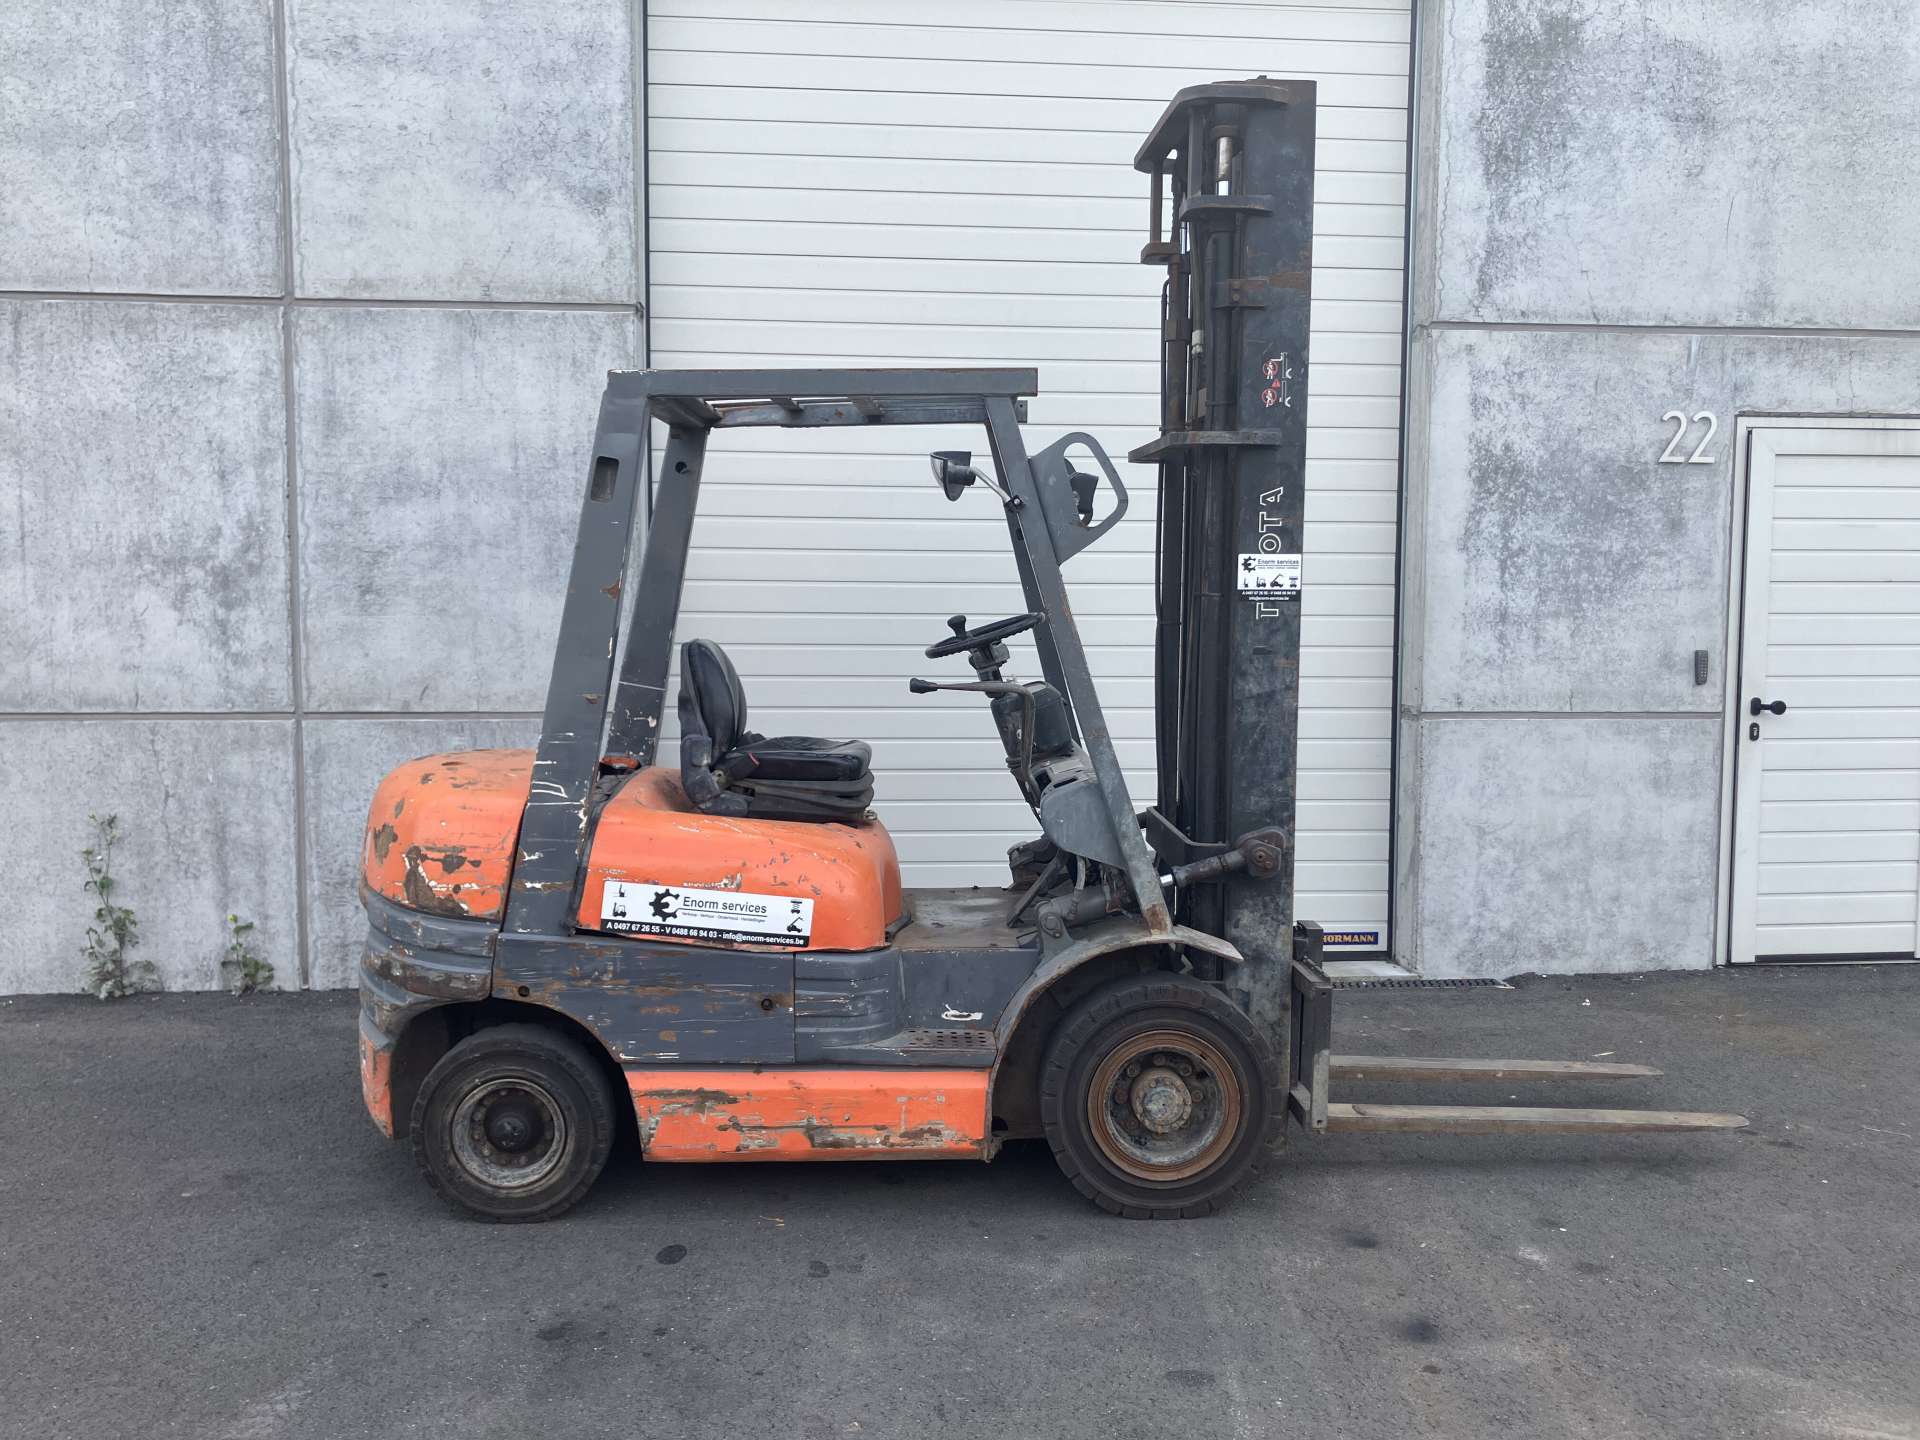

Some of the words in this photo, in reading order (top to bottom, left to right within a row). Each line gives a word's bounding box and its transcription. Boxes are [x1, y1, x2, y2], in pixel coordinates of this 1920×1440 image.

[1658, 410, 1717, 464] 22
[1256, 486, 1284, 620] TOTA
[682, 896, 718, 910] Enorm
[721, 901, 767, 914] services
[606, 921, 613, 929] A
[613, 922, 630, 931] 0497
[651, 925, 660, 933] 55
[665, 926, 671, 934] V
[722, 931, 804, 945] info@enorm-services.be
